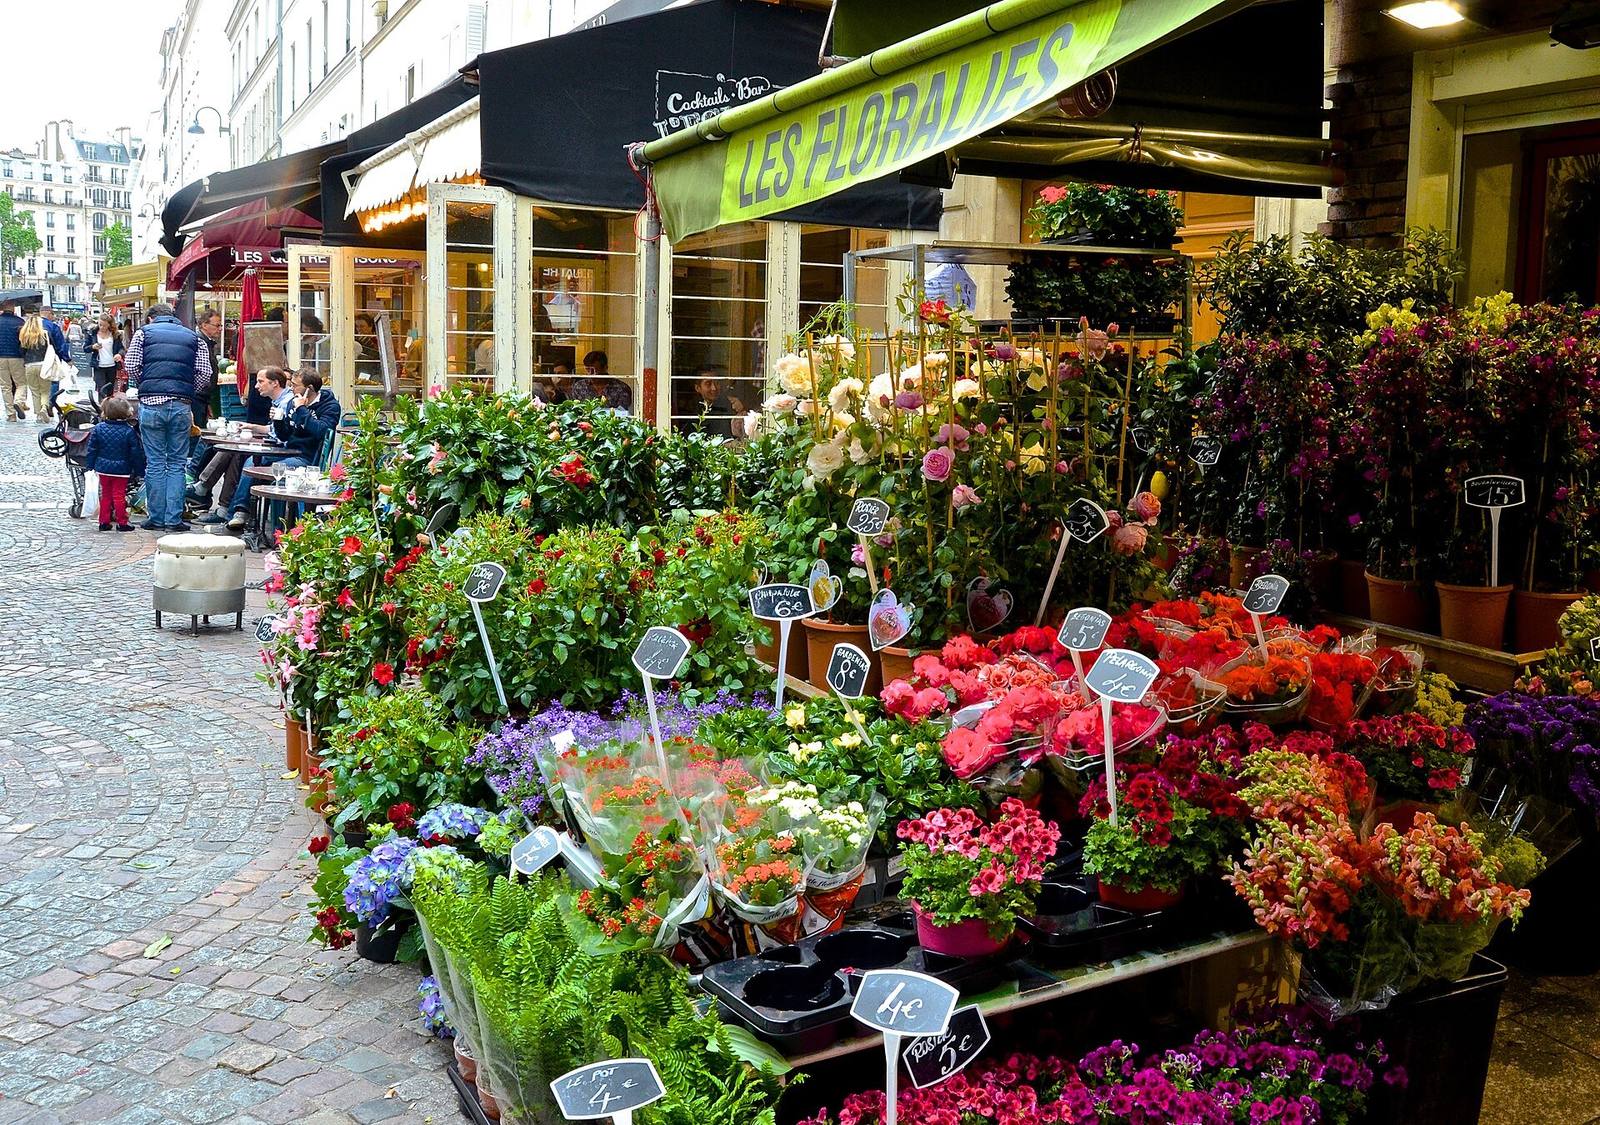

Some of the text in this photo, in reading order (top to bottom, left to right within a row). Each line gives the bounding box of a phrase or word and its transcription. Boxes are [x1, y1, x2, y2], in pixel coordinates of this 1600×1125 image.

[667, 77, 769, 114] Cocktails Bar
[739, 22, 1075, 209] LES FLORALIES
[235, 251, 263, 263] LES
[566, 1066, 619, 1089] LE POT
